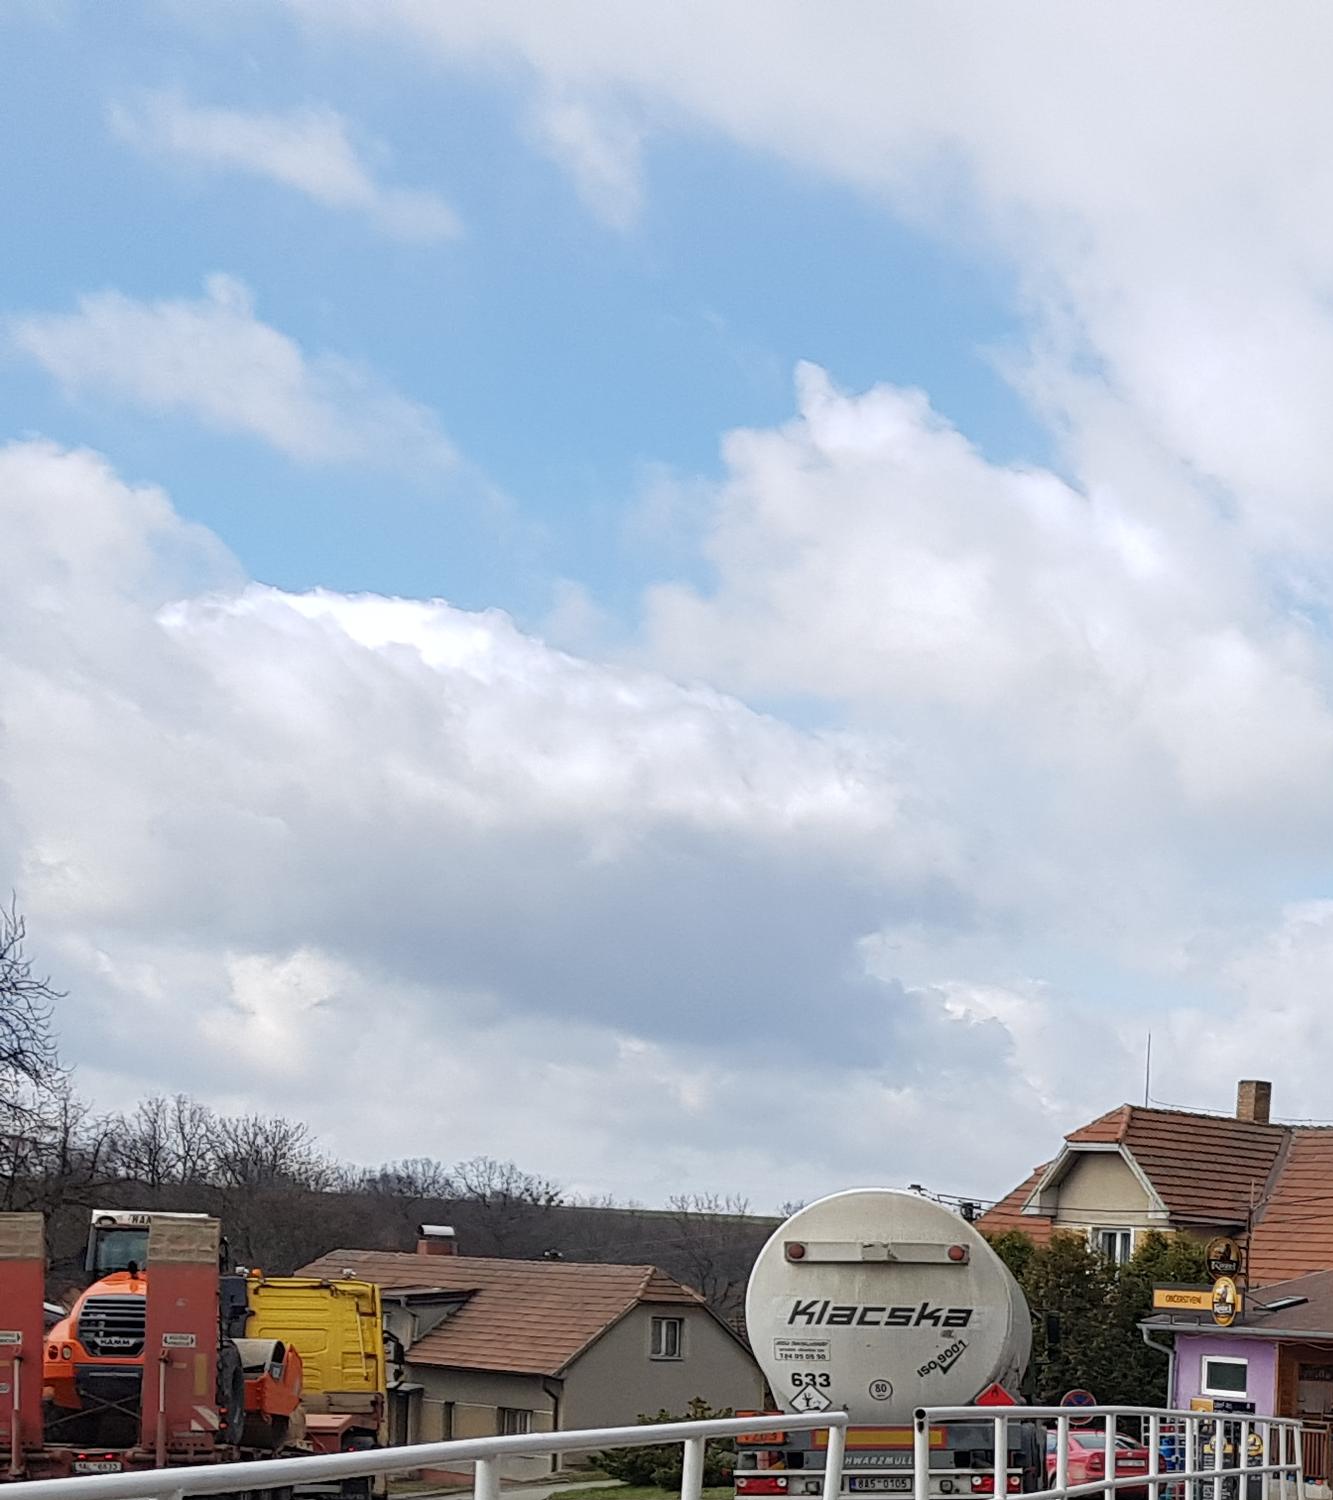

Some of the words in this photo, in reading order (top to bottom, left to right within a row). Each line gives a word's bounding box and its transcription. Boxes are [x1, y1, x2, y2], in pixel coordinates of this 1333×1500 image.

[787, 1300, 974, 1327] Klacska
[100, 1338, 131, 1346] HAMM
[917, 1360, 938, 1378] ISO
[937, 1339, 969, 1366] 9001
[791, 1372, 831, 1388] 633
[875, 1383, 887, 1393] 80
[858, 1479, 876, 1489] 8A5
[883, 1479, 907, 1489] 0105
